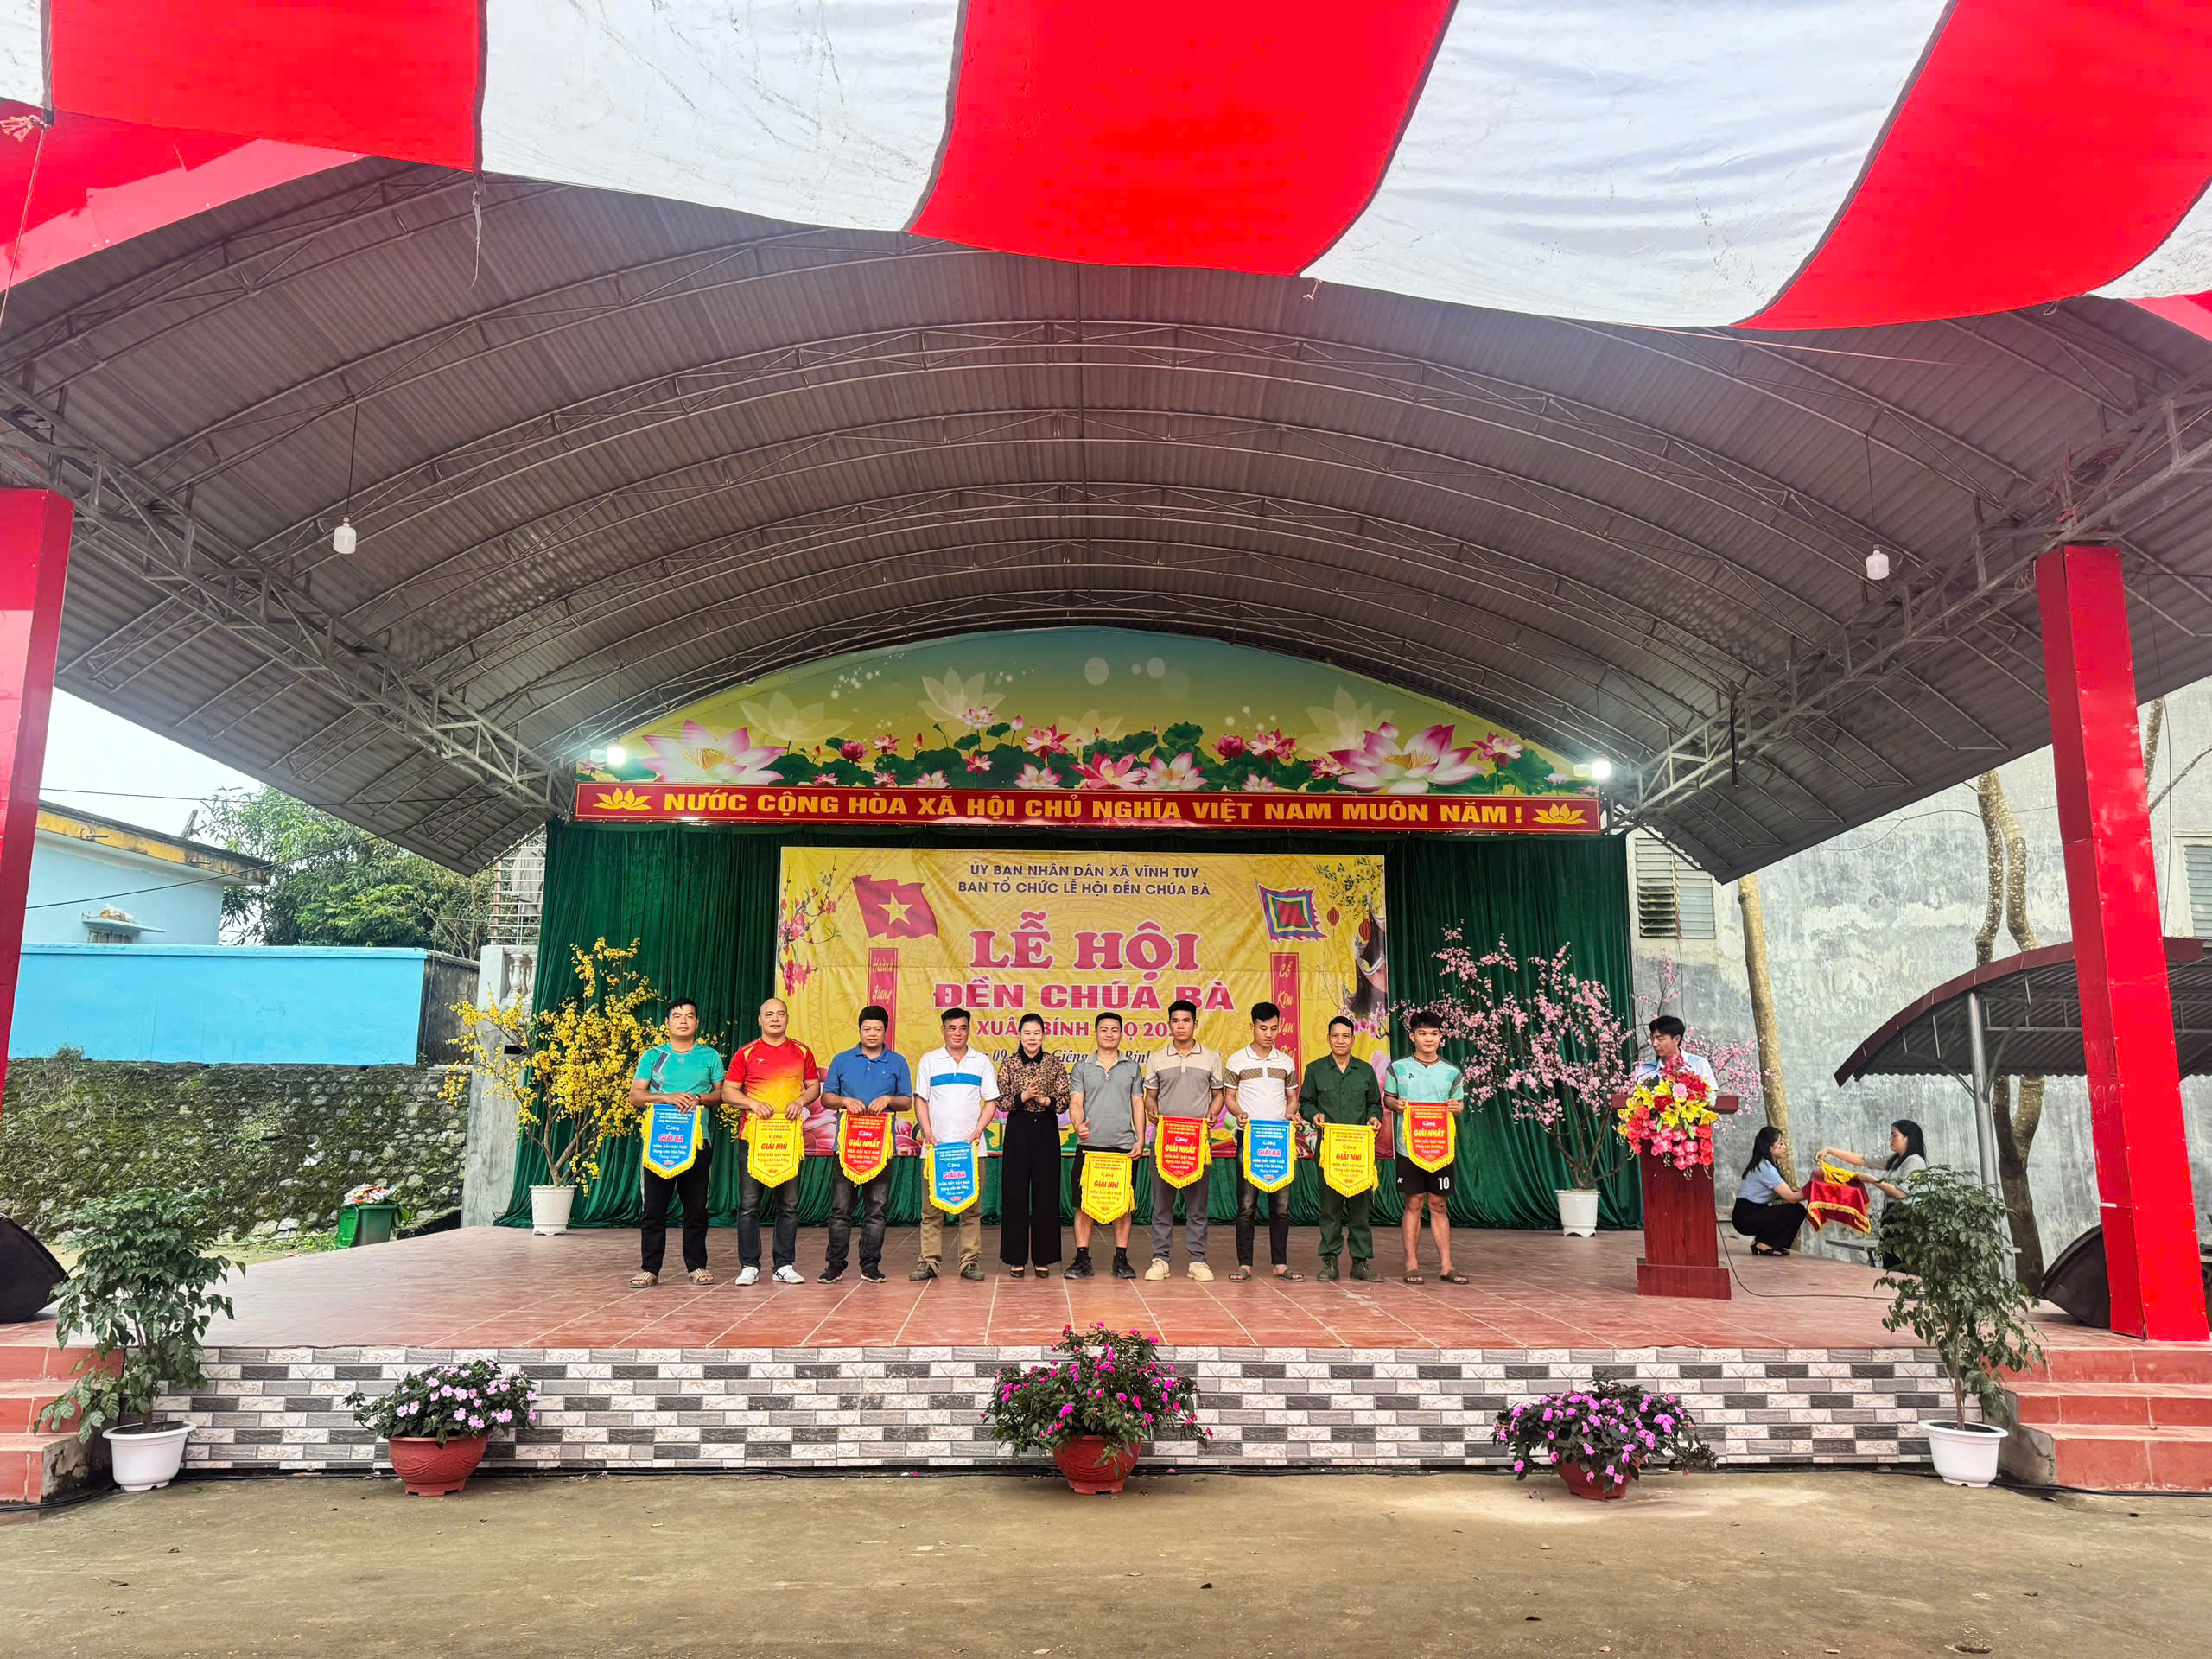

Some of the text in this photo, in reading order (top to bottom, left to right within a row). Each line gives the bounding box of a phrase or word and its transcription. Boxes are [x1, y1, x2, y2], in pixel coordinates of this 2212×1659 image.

[664, 789, 747, 811] NƯỚC
[757, 791, 838, 816] CỘNG
[849, 792, 907, 814] HÒA
[917, 795, 957, 816] XÃ
[967, 795, 1014, 819] HỘI
[1025, 794, 1082, 817] CHỦ
[1092, 798, 1182, 818] NGHĨA
[1192, 798, 1253, 822] VIỆT
[1265, 803, 1331, 820] NAM
[1343, 800, 1427, 821] MUÔN
[1440, 801, 1507, 823] NĂM
[970, 861, 1198, 878] ỦY BAN NHÂN DÂN XÃ VĨNH TUY
[958, 876, 1211, 897] BAN TỔ CHỨC LỄ HỘI ĐỀN CHÚA BÀ
[969, 911, 1201, 982] LỄ HỘI
[873, 957, 893, 973] Hoành
[872, 985, 892, 1004] Giang
[933, 976, 1235, 1009] ĐỀN CHÚA BÀ
[1277, 990, 1294, 1009] Kim
[1438, 1177, 1450, 1190] 10
